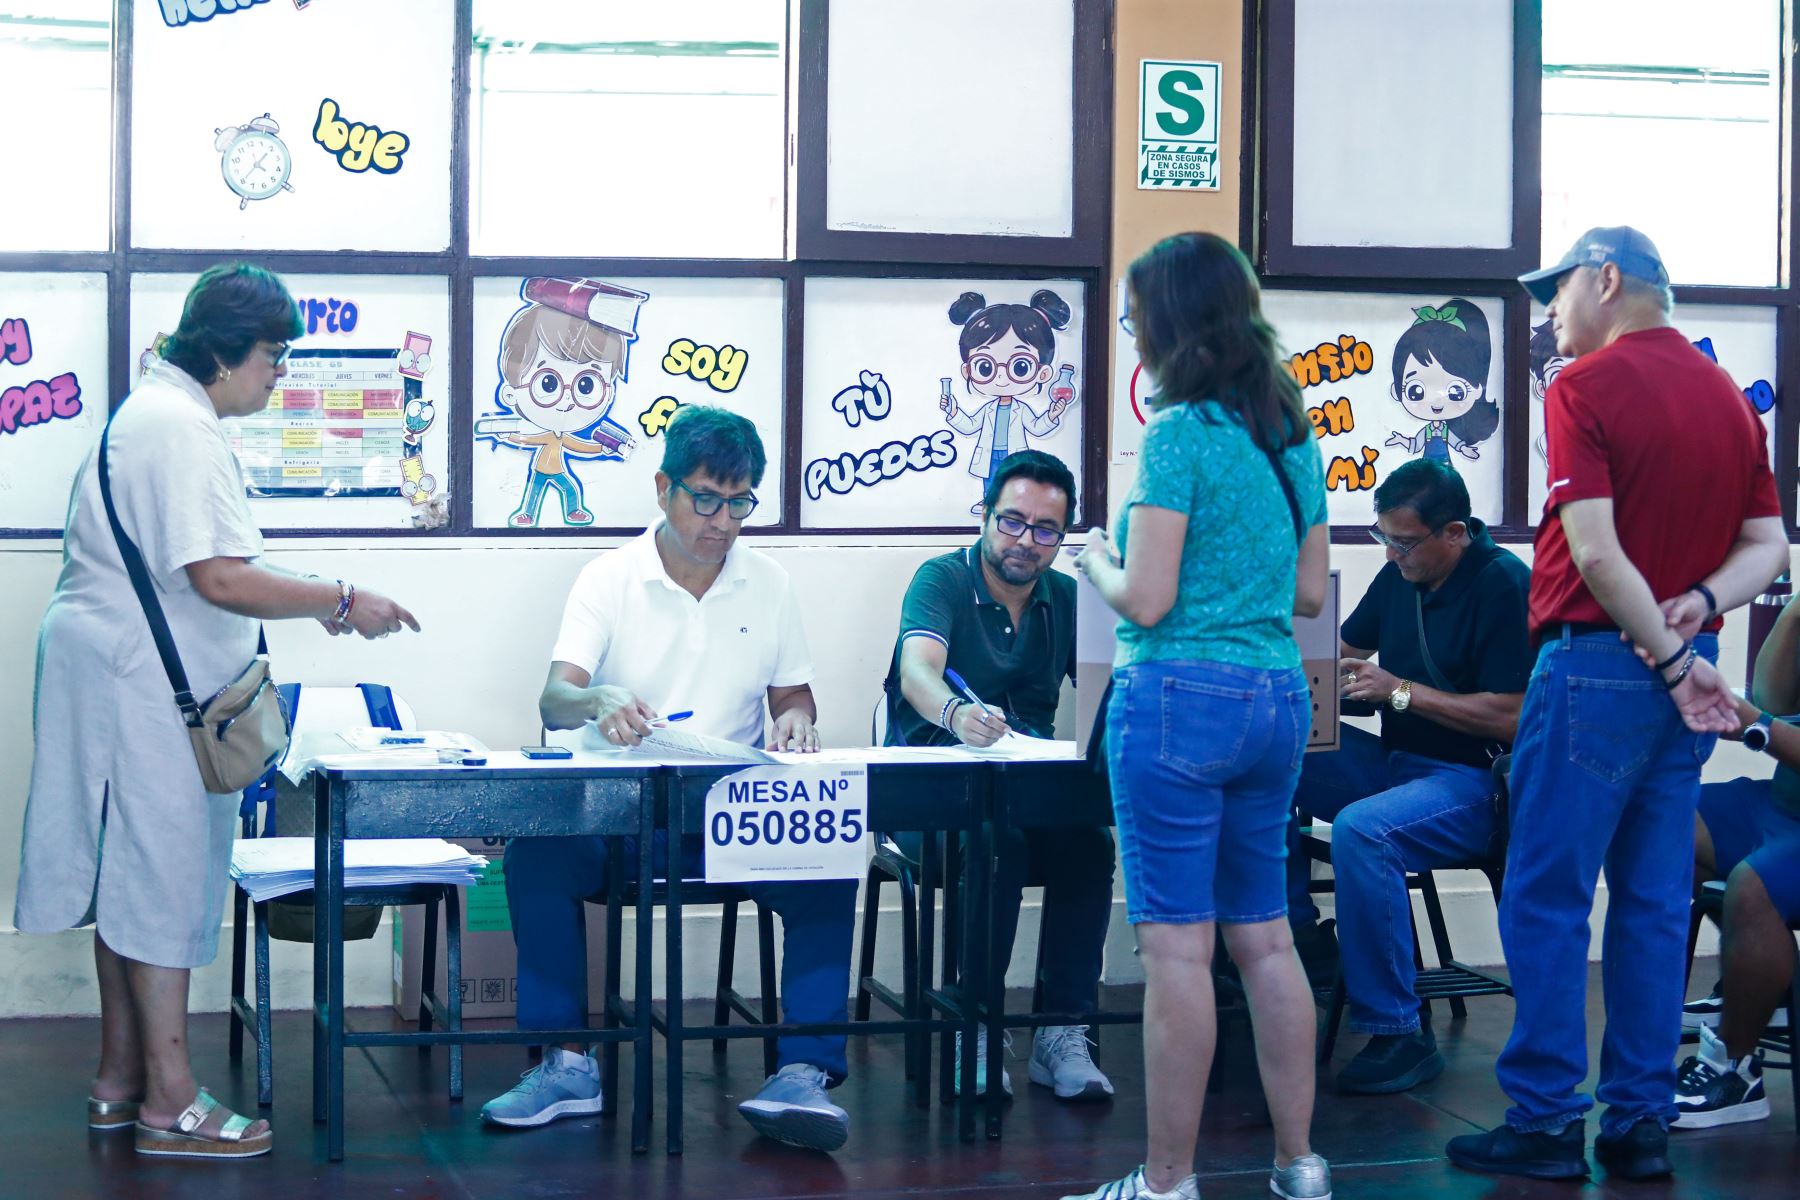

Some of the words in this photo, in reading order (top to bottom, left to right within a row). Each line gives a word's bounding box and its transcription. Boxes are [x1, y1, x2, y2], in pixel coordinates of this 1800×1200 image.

[1156, 70, 1205, 136] S
[313, 98, 410, 175] bye
[1150, 153, 1172, 161] ZONA
[1175, 154, 1208, 162] SEGURA
[1157, 161, 1170, 169] EN
[1171, 162, 1201, 170] CASOS
[1153, 169, 1166, 177] DE
[1168, 170, 1205, 179] SISMOS
[289, 360, 323, 368] CLASE
[0, 371, 83, 435] PAZ
[805, 429, 957, 500] PUEDES
[728, 780, 811, 804] MESA
[711, 809, 863, 847] 050885
